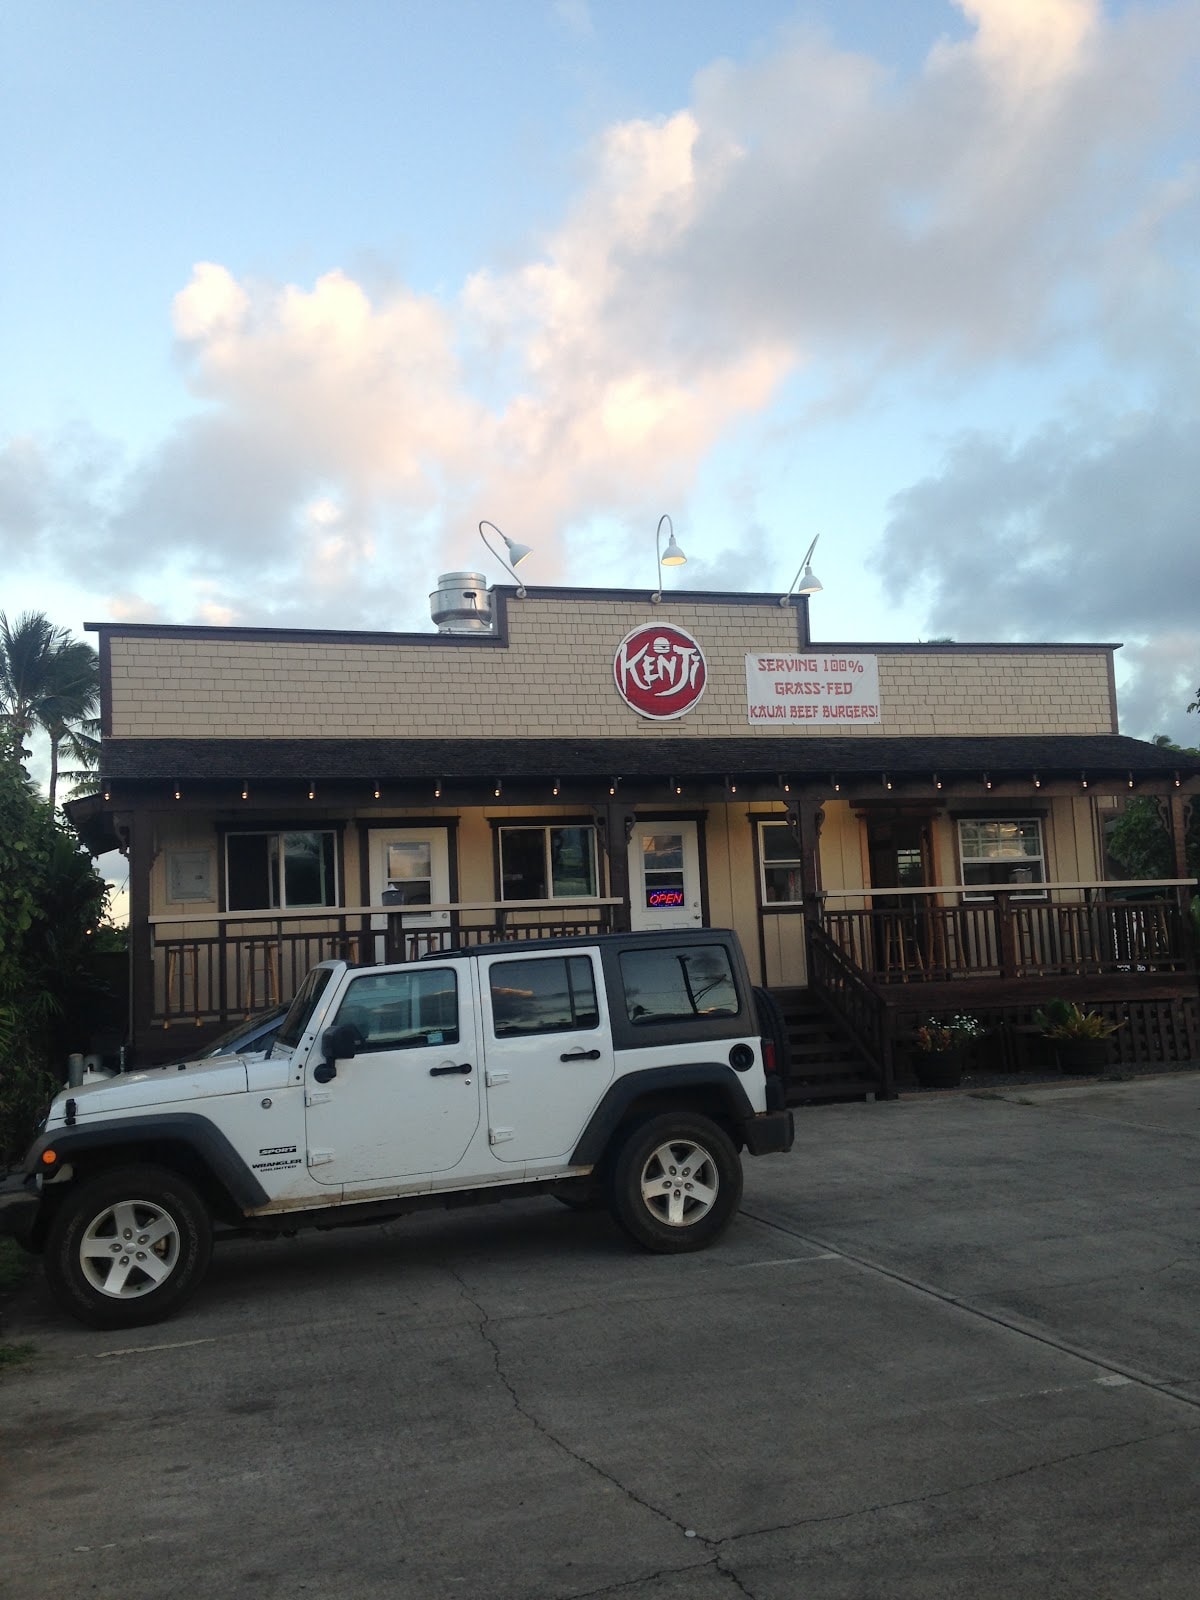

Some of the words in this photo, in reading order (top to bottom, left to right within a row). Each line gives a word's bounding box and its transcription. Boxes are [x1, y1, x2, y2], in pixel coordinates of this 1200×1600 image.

[758, 659, 818, 672] SERVING
[824, 659, 864, 673] 100%
[775, 682, 853, 695] GRASS-FED
[750, 704, 787, 718] KAUAI
[790, 705, 819, 718] BEEF
[822, 705, 879, 718] BURGERS!
[650, 894, 682, 904] OPEN
[260, 1146, 296, 1156] SPORT
[252, 1159, 302, 1169] WRANGLER
